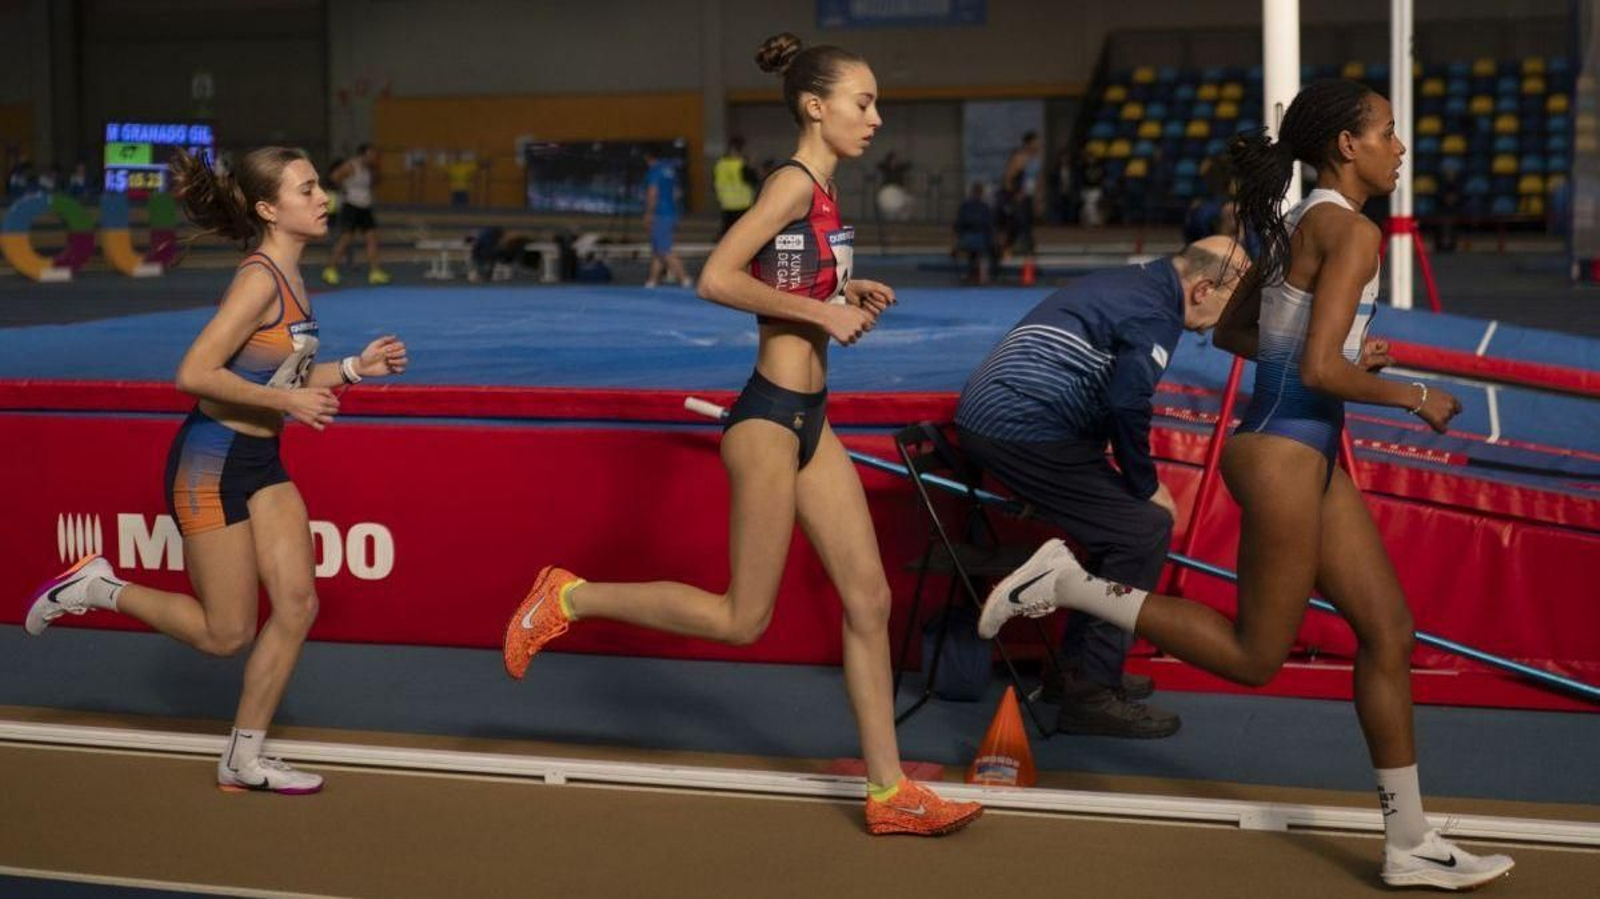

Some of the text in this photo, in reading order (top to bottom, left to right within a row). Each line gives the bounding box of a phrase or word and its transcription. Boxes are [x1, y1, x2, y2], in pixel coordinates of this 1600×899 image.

[121, 124, 187, 143] GRANADO
[188, 126, 213, 144] GIL
[777, 252, 788, 267] DE
[790, 253, 801, 290] XUNTA
[117, 513, 395, 580] MDO
